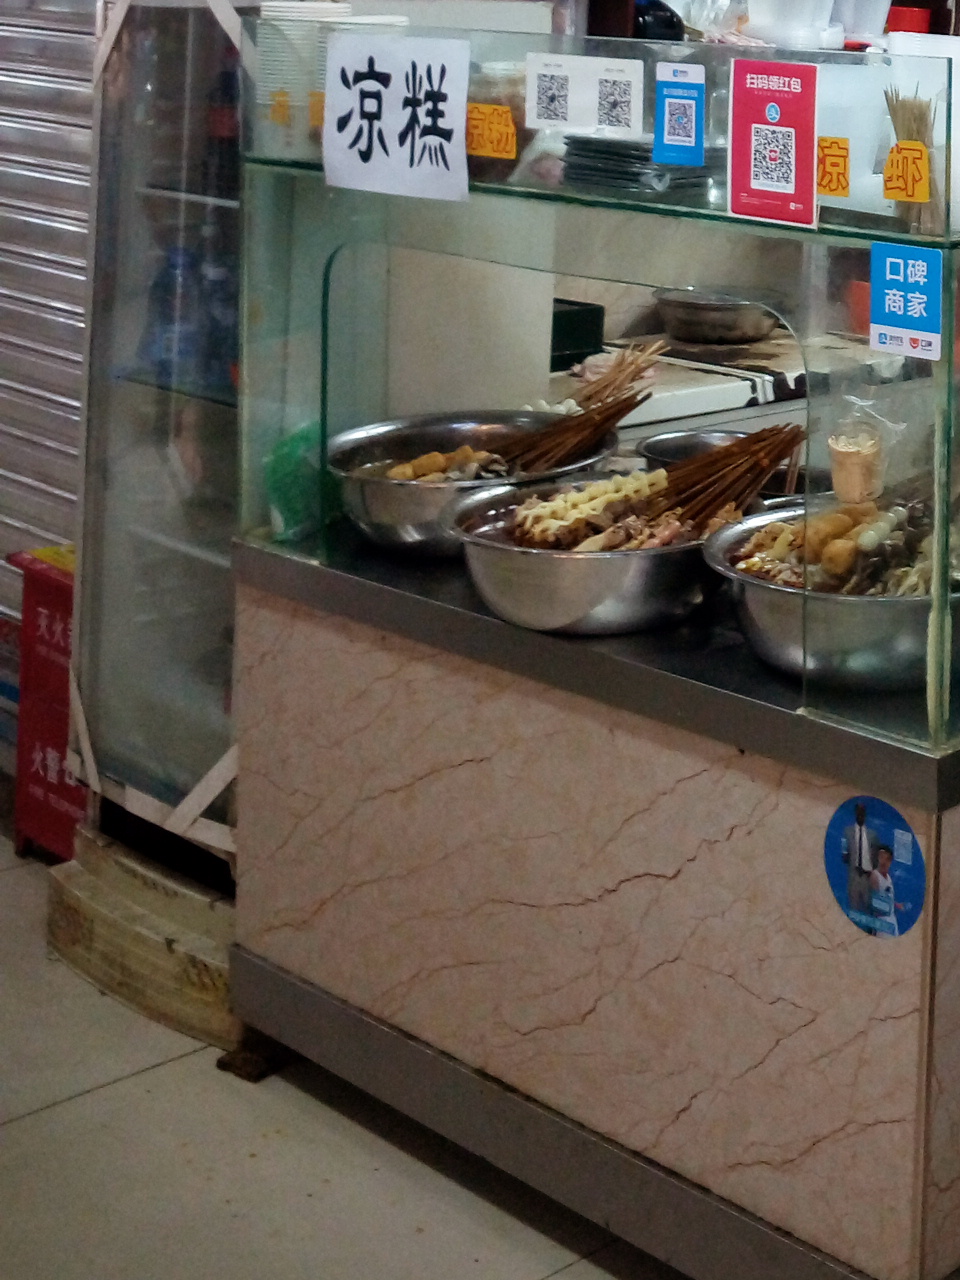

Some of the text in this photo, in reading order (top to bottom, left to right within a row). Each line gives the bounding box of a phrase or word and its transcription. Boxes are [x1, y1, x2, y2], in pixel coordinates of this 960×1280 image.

[745, 73, 803, 93] 扫码领红包
[337, 54, 456, 172] 凉糕
[884, 145, 924, 198] 虾
[885, 256, 928, 286] 口碑
[884, 288, 928, 318] 商家
